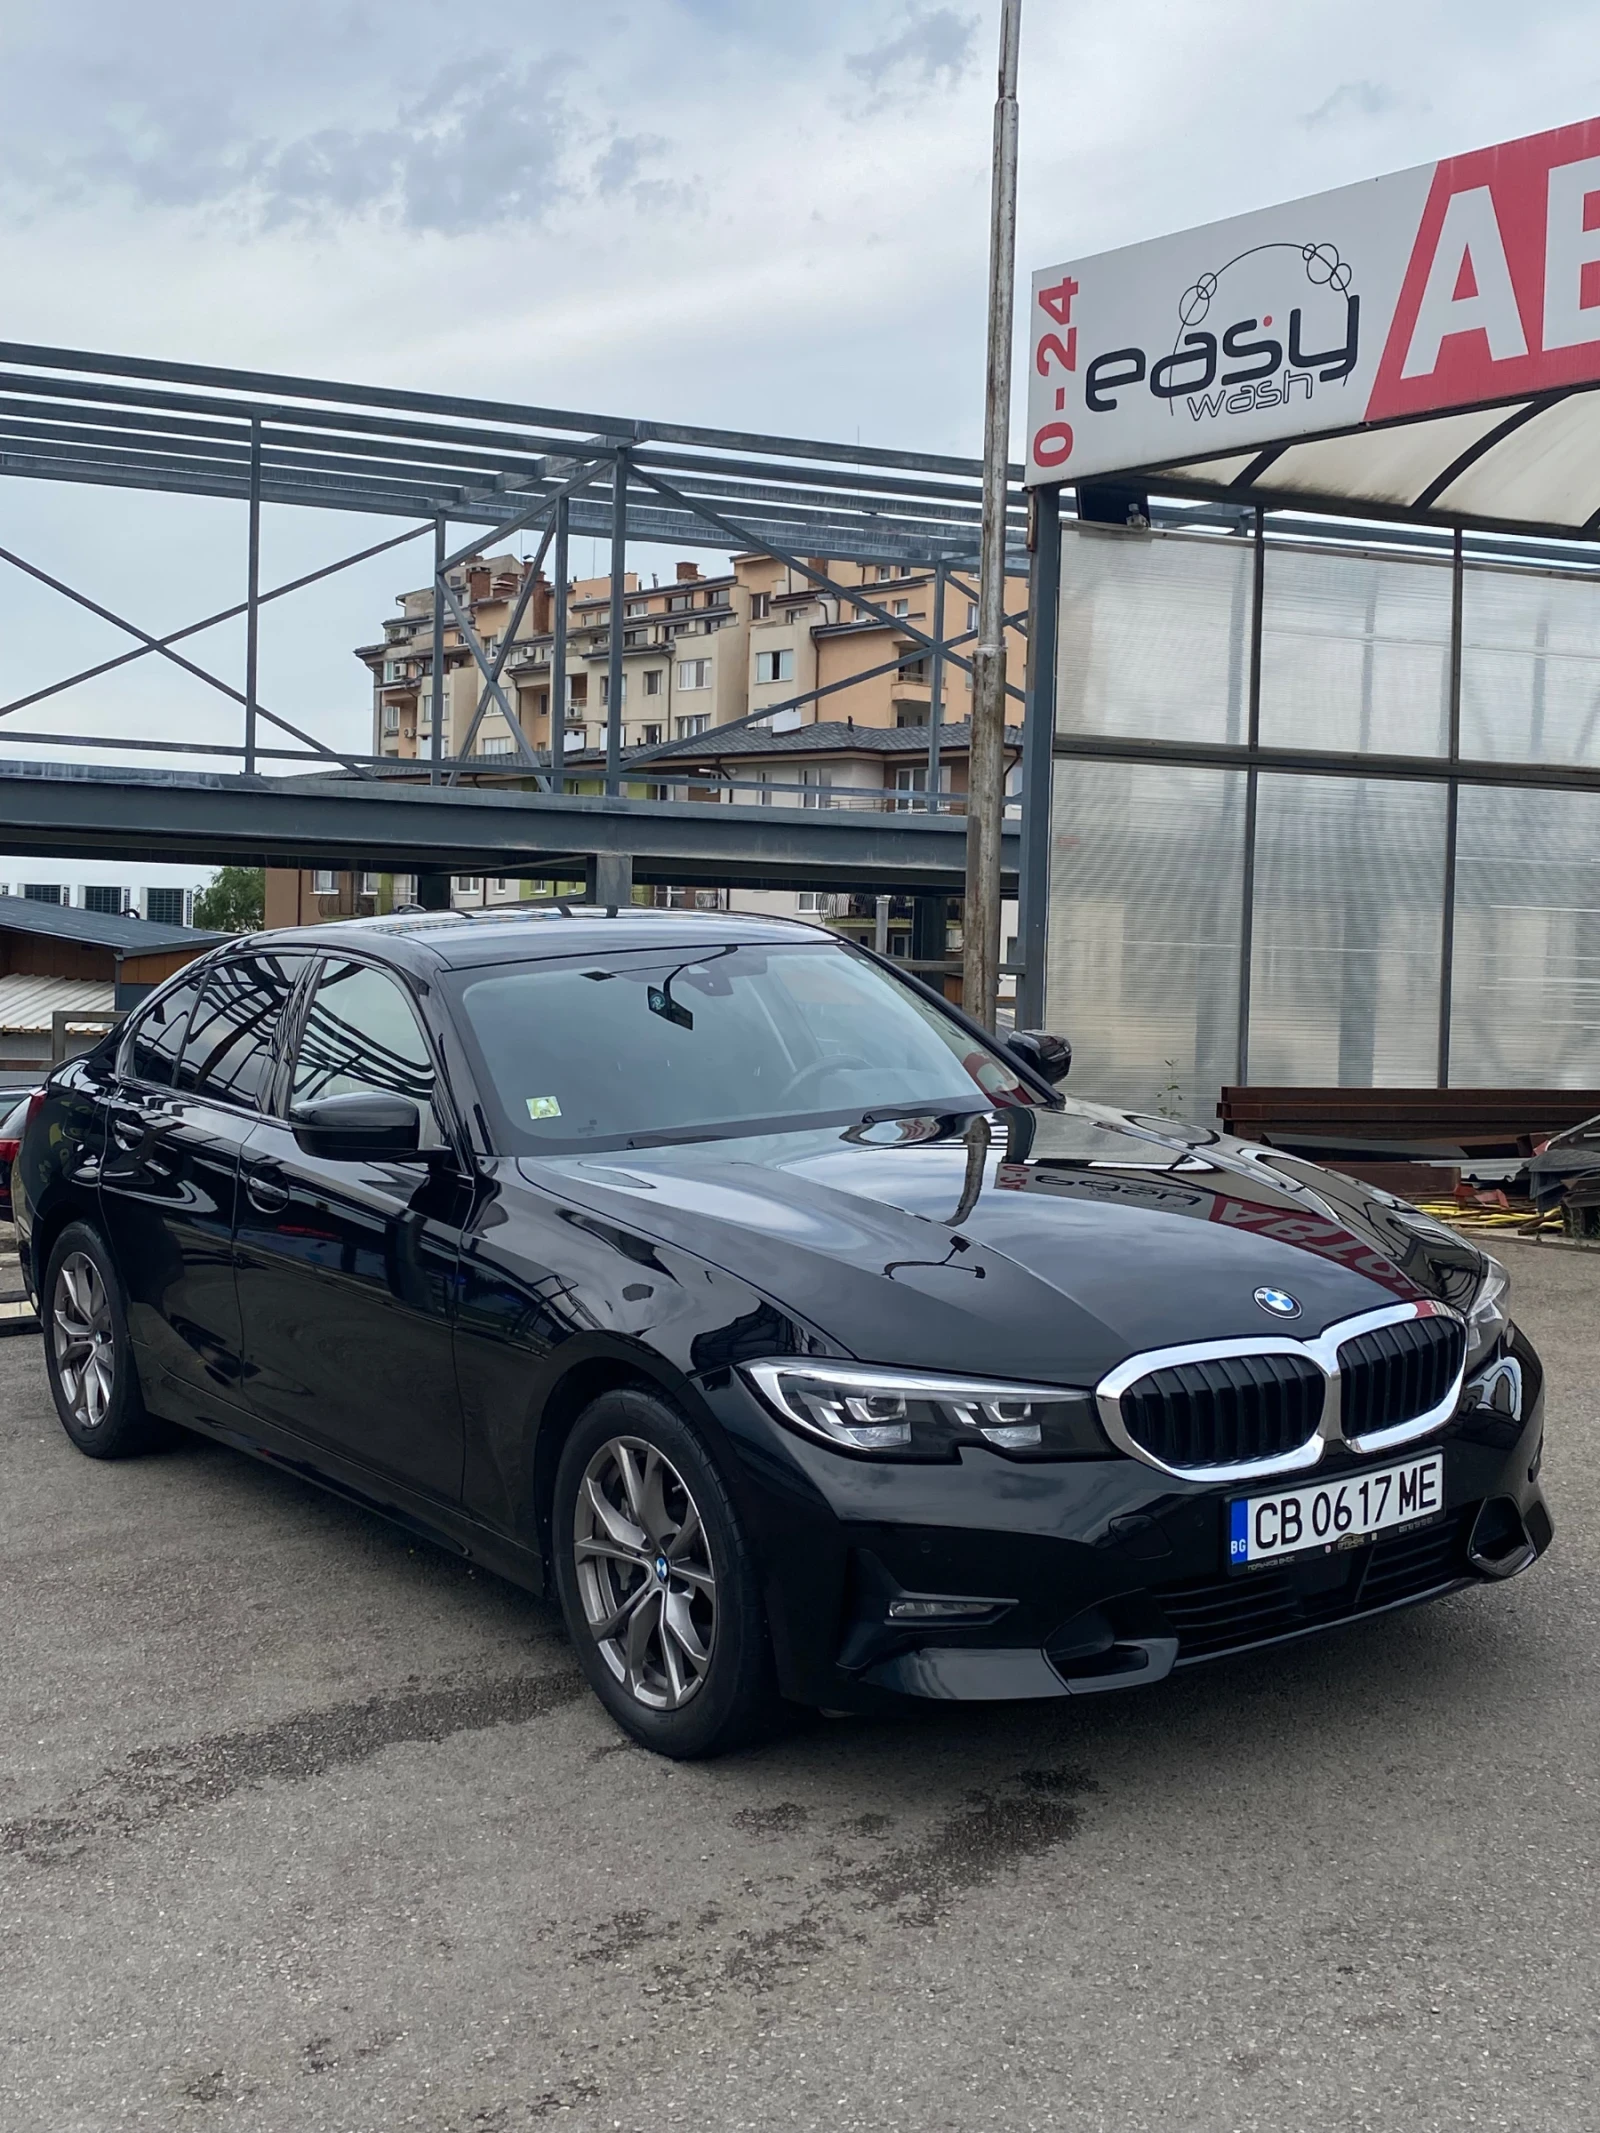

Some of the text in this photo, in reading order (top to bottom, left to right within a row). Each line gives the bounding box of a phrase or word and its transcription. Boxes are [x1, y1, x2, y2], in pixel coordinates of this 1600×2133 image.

[1033, 277, 1079, 467] 0-24
[1086, 295, 1361, 413] easy
[1187, 369, 1313, 421] wash
[1230, 1538, 1247, 1555] BG
[1255, 1462, 1437, 1549] CB 0617 ME
